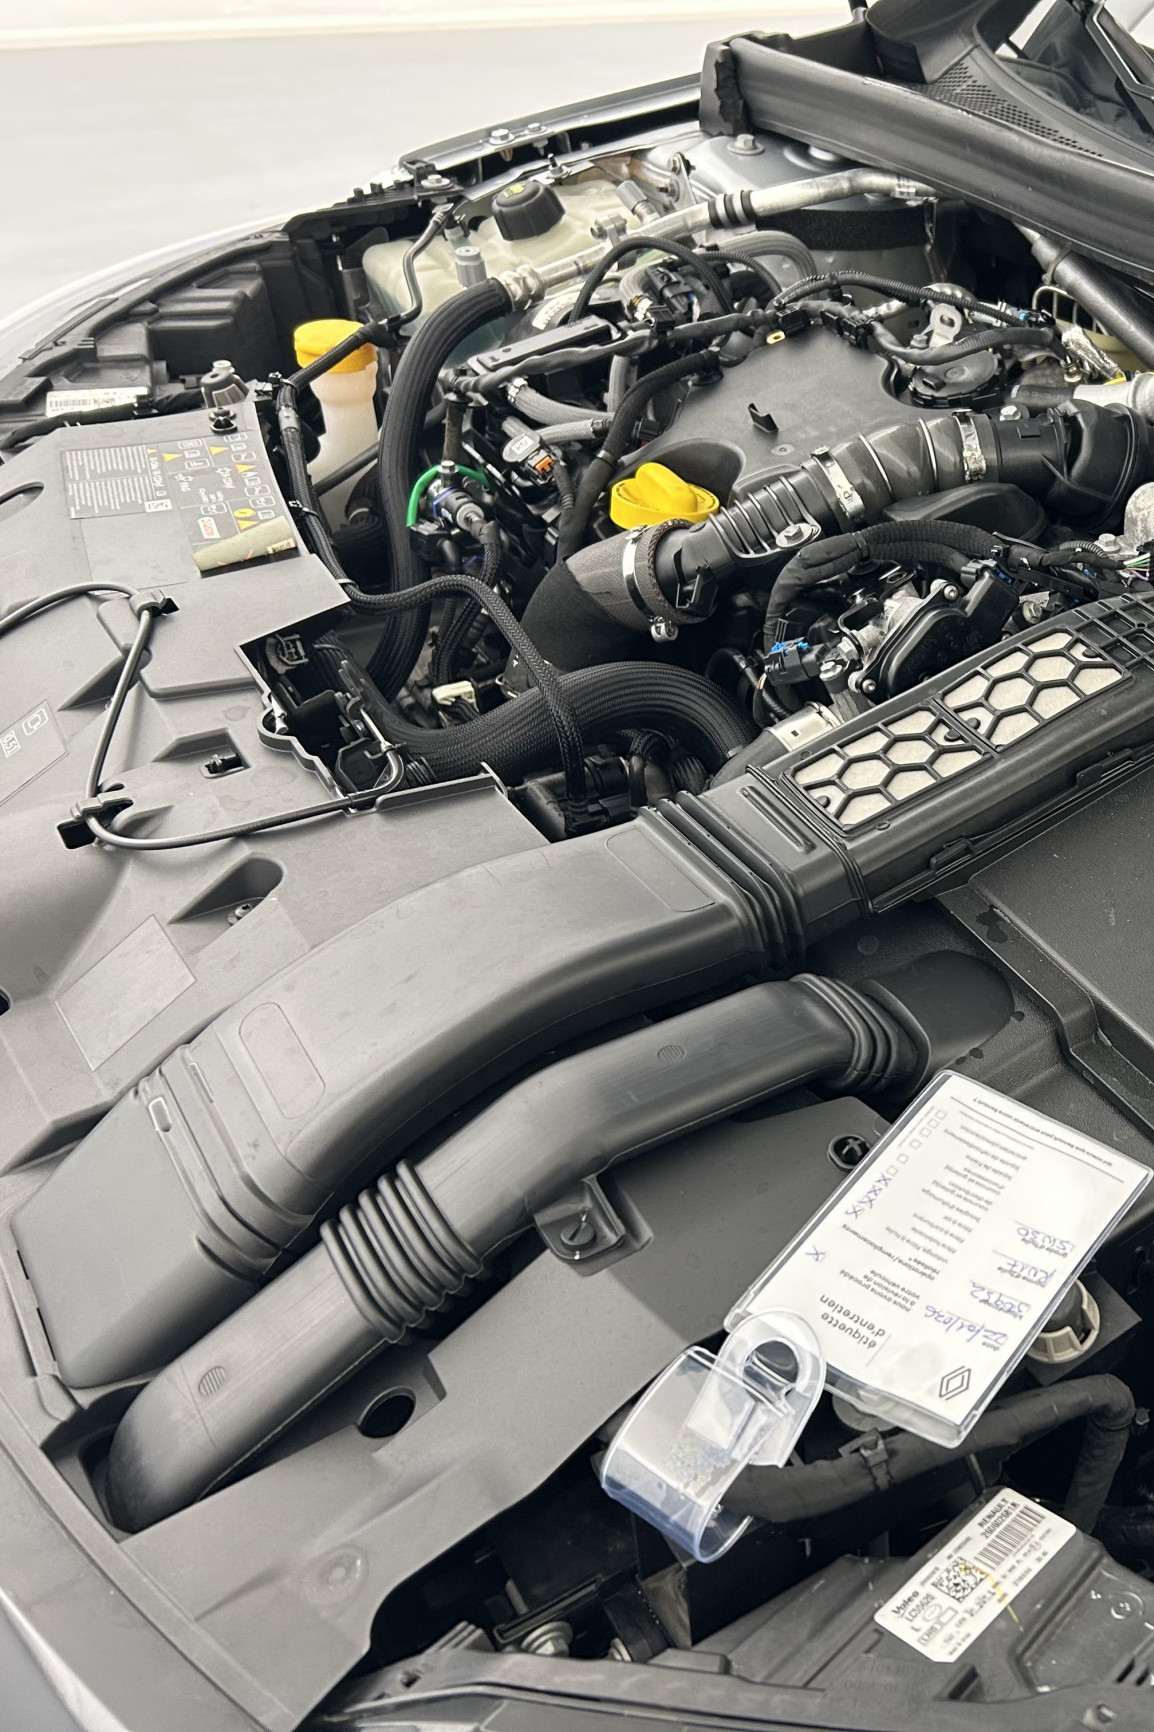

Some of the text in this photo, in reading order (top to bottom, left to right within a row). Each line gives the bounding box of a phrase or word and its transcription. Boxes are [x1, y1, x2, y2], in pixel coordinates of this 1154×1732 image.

[839, 1269, 911, 1312] nous avons procédé
[862, 1274, 873, 1282] de
[870, 1269, 920, 1300] votre véhicule
[872, 1279, 902, 1299] révision
[901, 1295, 910, 1304] la
[819, 1294, 886, 1337] d'entretien
[820, 1312, 877, 1349] étiquette
[891, 1590, 920, 1615] Valeo
